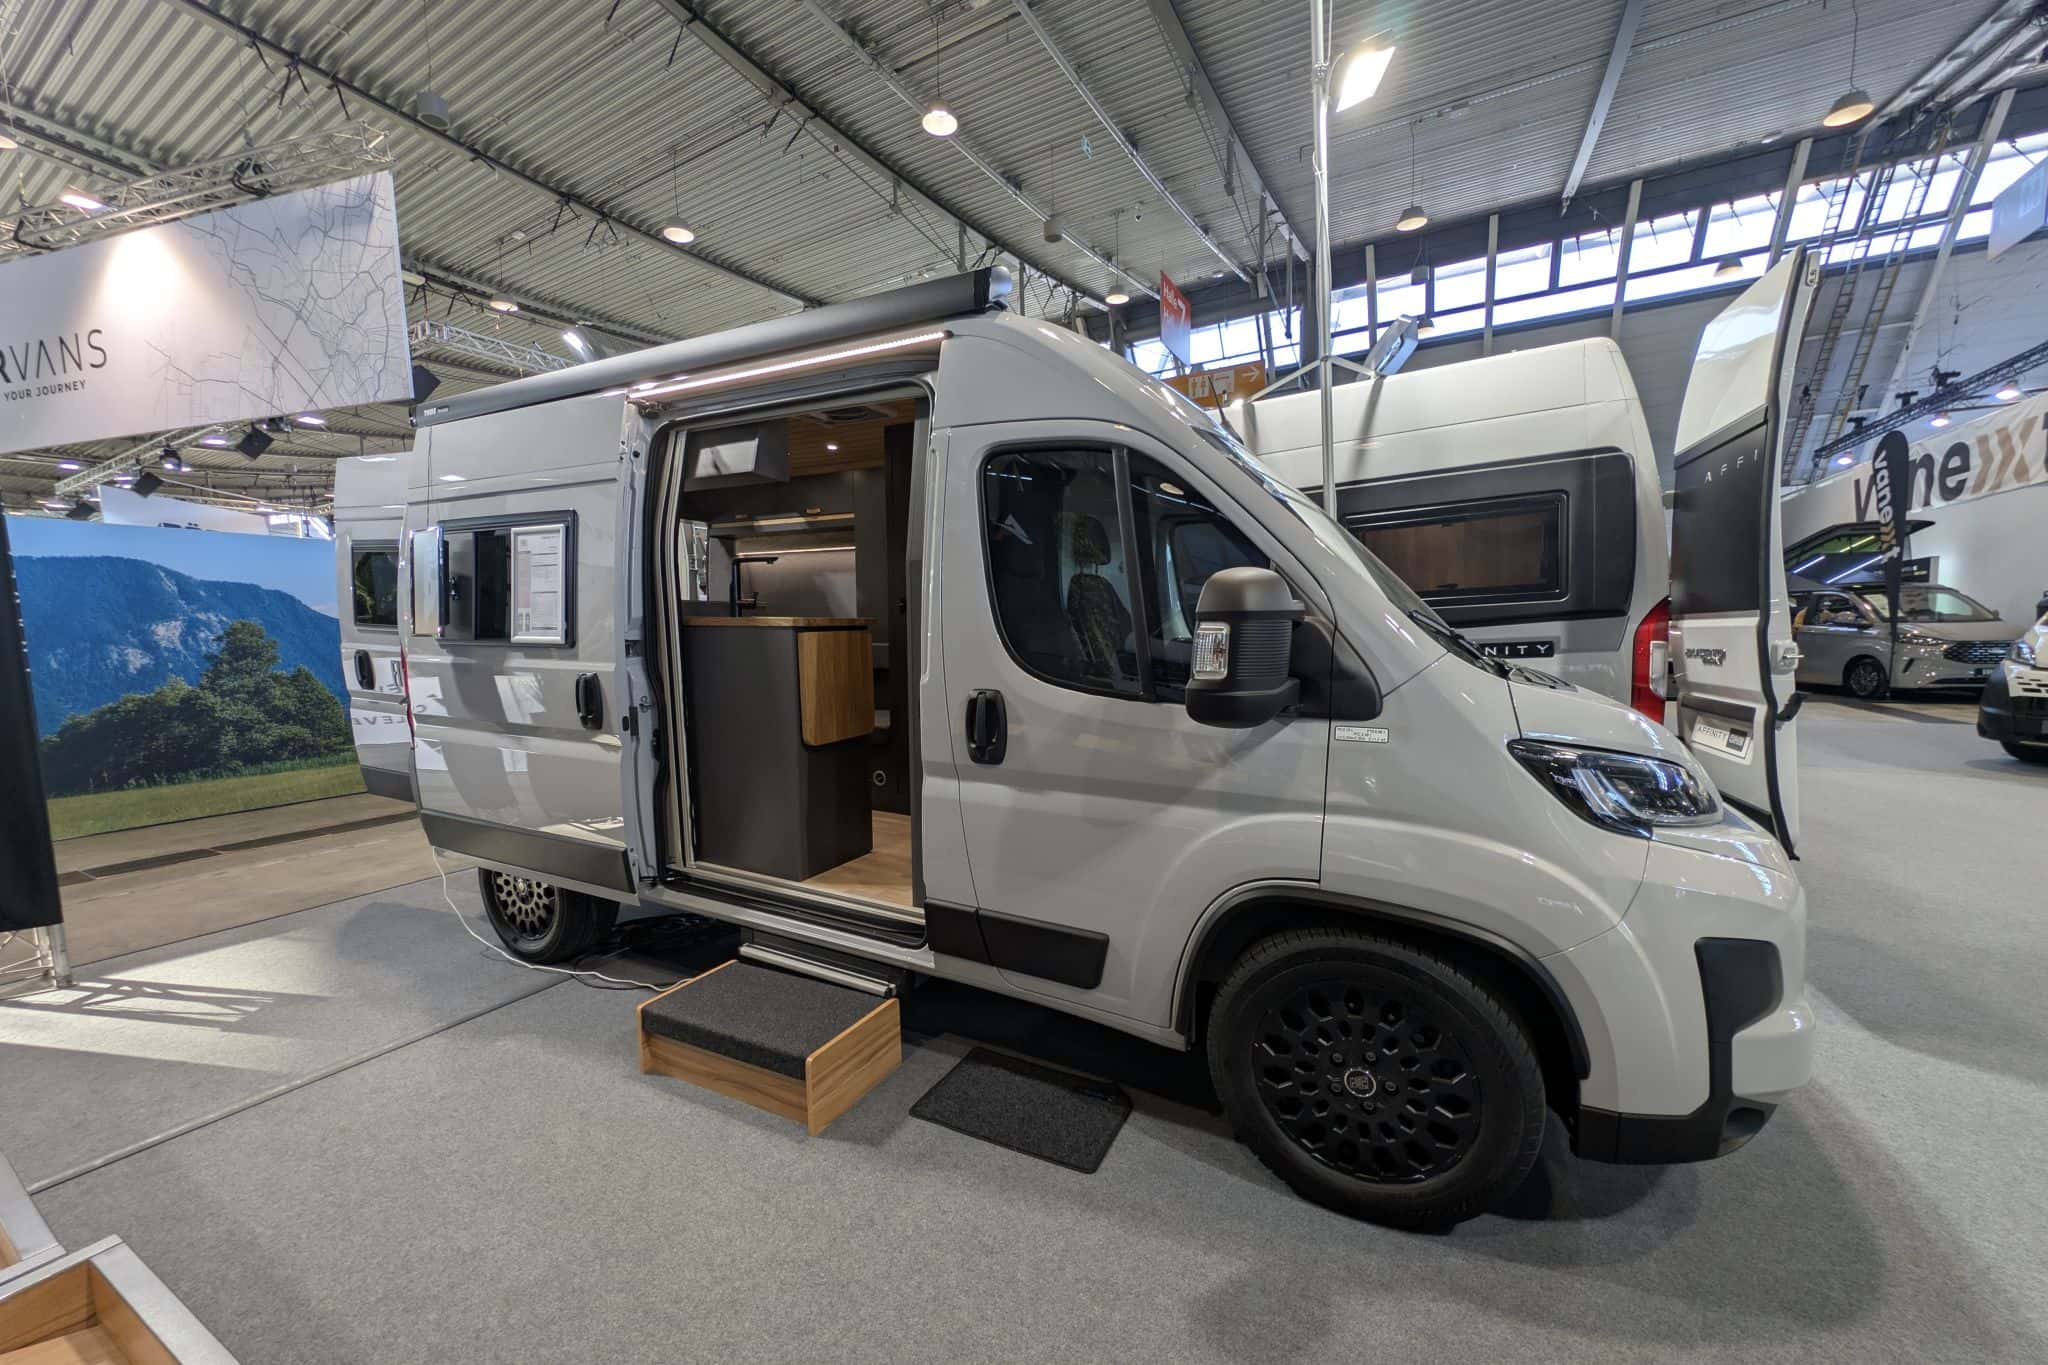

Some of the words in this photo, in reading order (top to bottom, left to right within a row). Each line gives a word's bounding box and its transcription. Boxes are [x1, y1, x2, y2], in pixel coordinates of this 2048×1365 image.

[3, 389, 32, 401] YOUR
[36, 380, 86, 397] JOURNEY
[1484, 644, 1549, 656] NITY
